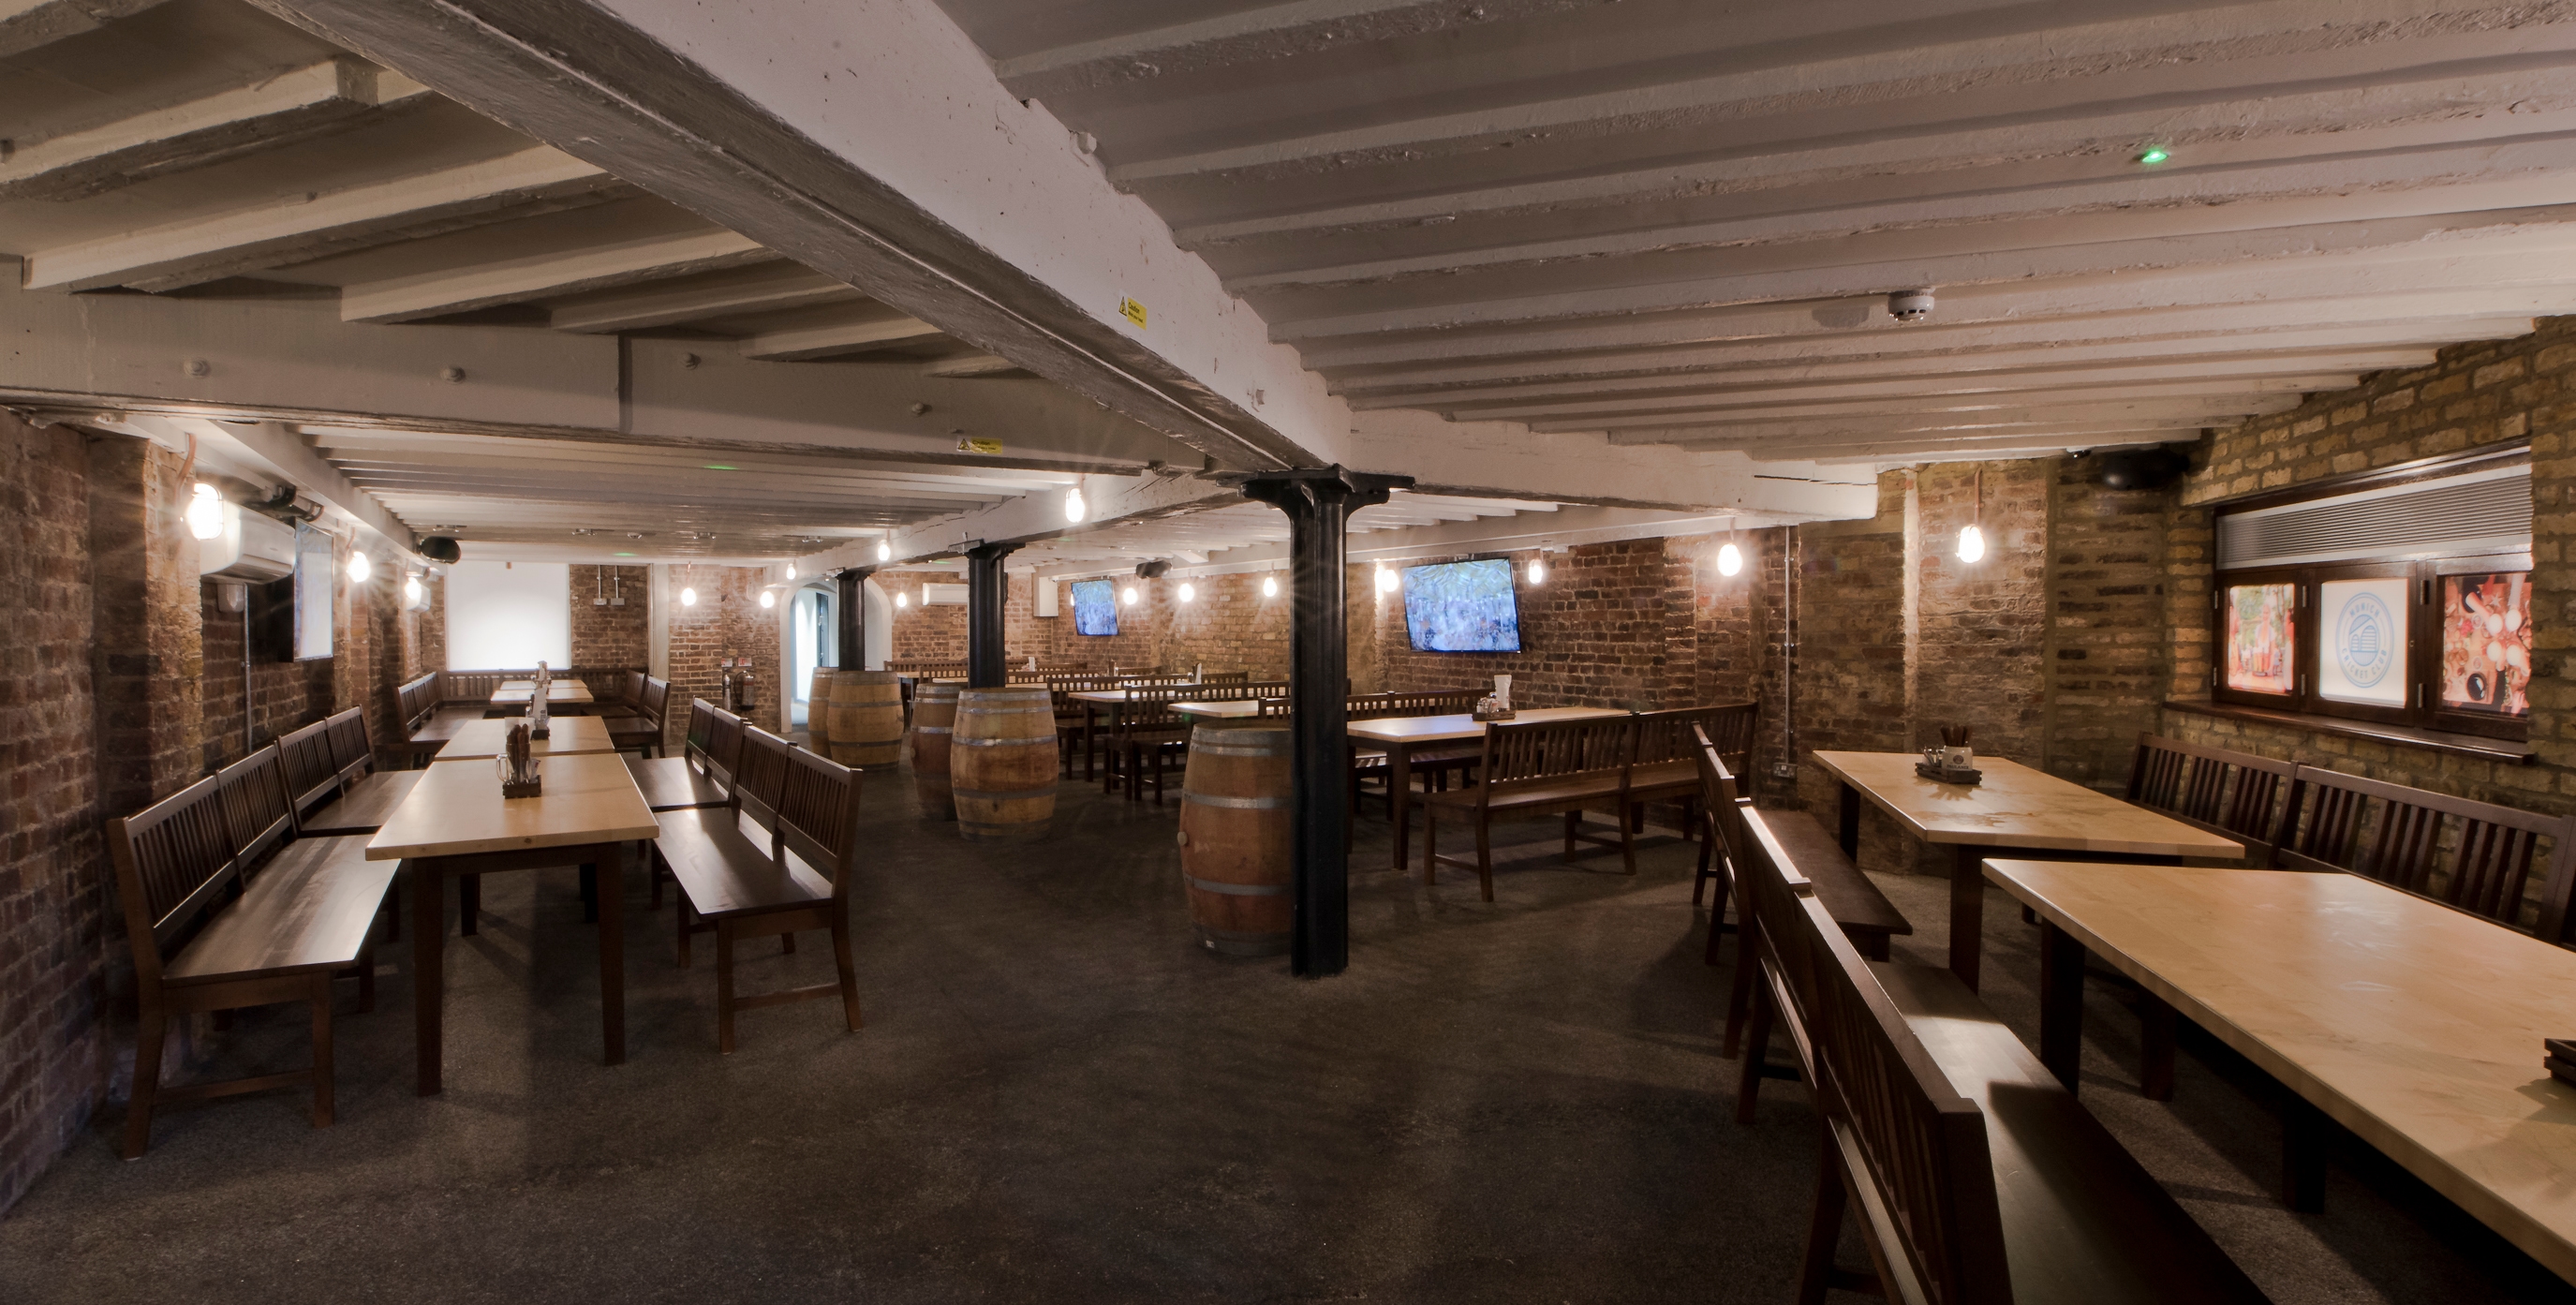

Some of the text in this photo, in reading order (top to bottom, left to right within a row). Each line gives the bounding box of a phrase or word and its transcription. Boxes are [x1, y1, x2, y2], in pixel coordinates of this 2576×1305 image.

[1128, 302, 1140, 314] Caution
[2349, 602, 2380, 617] MUNICH
[2342, 647, 2388, 679] CRICKET CLUB
